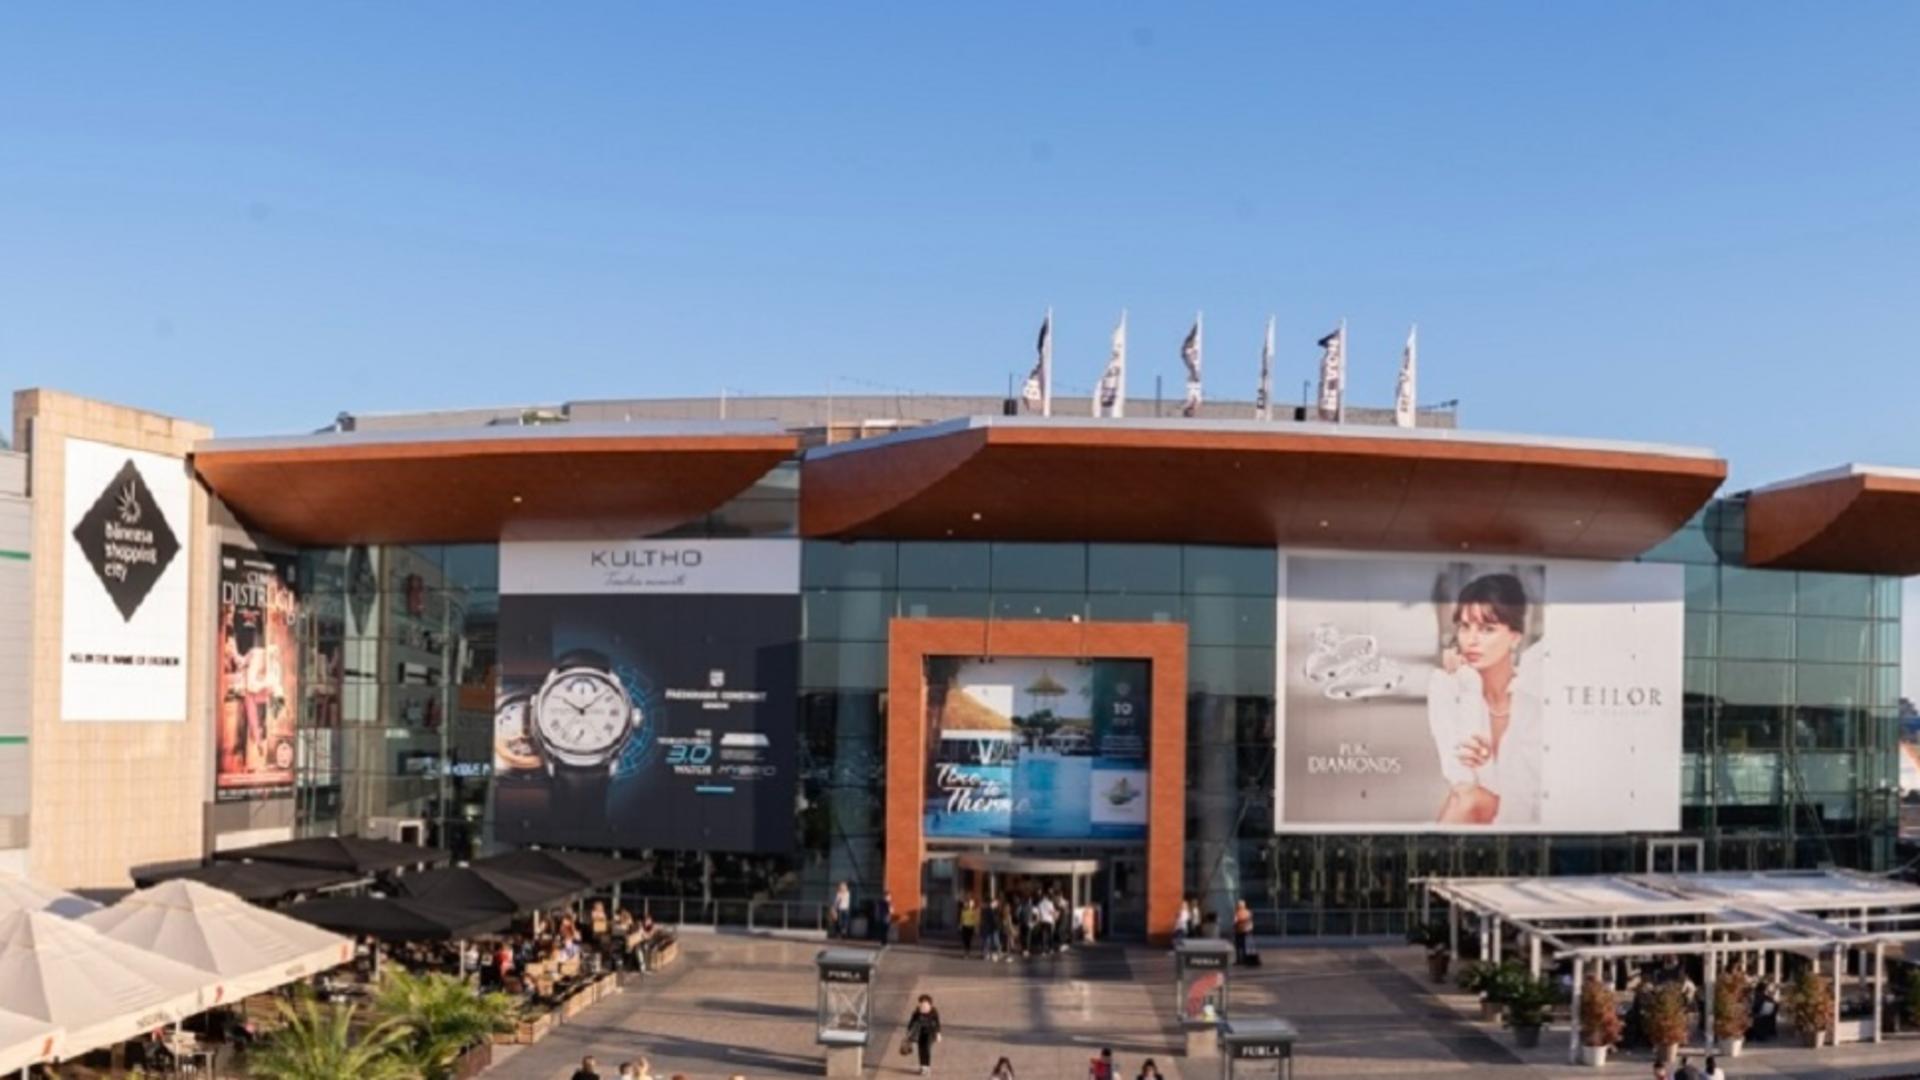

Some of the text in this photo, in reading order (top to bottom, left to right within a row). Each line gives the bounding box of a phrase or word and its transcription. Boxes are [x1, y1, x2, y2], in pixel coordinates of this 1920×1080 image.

[591, 549, 703, 567] KULTHO
[105, 563, 128, 583] city
[1563, 685, 1663, 706] TEILOR
[1308, 756, 1401, 775] DIAMONDS
[1241, 1045, 1280, 1056] FURLA
